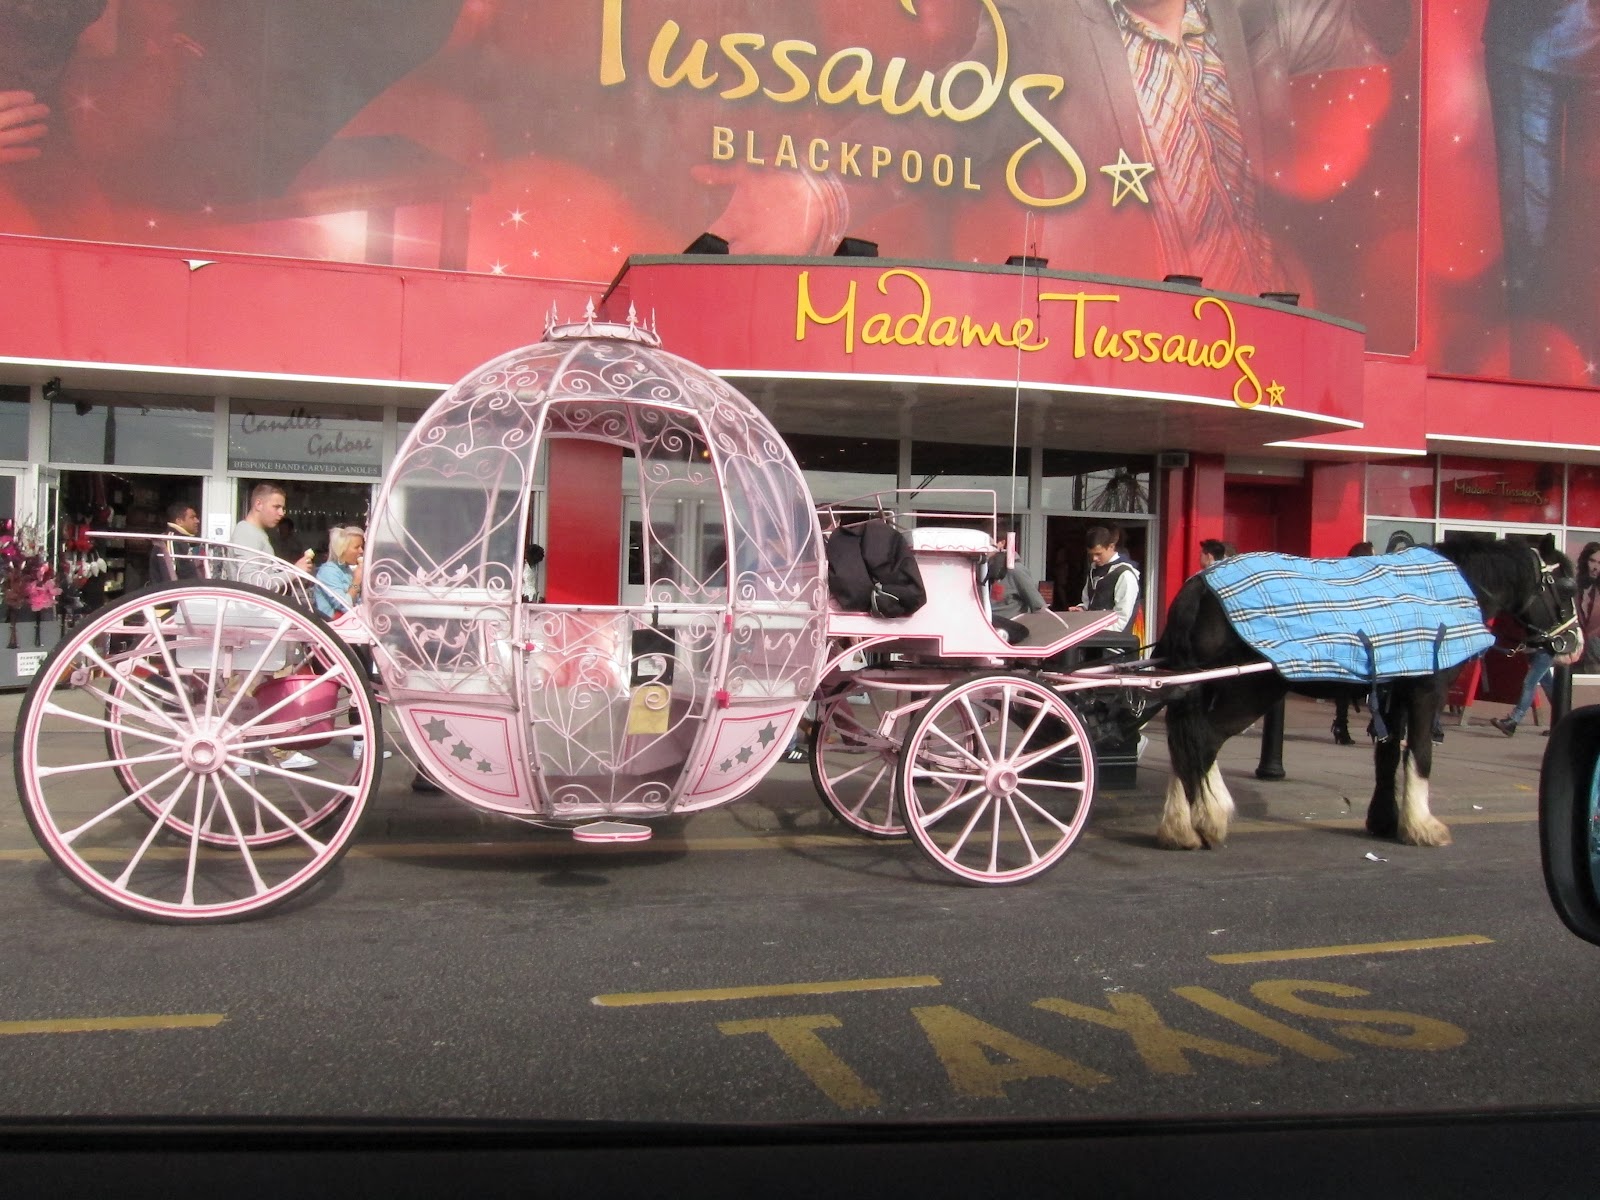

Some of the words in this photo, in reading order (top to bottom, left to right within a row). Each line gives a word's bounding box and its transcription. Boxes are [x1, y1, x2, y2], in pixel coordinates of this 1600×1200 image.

[712, 126, 981, 191] BLACKPOOL
[795, 269, 1049, 354] Madame
[1039, 291, 1263, 409] Tussauds
[241, 406, 322, 434] Candles
[233, 460, 273, 470] BESPOKE
[275, 462, 300, 471] HAND
[301, 463, 337, 473] CARVED
[338, 465, 378, 474] CANDLES
[308, 431, 373, 457] Galore
[717, 978, 1468, 1110] TAXIS
